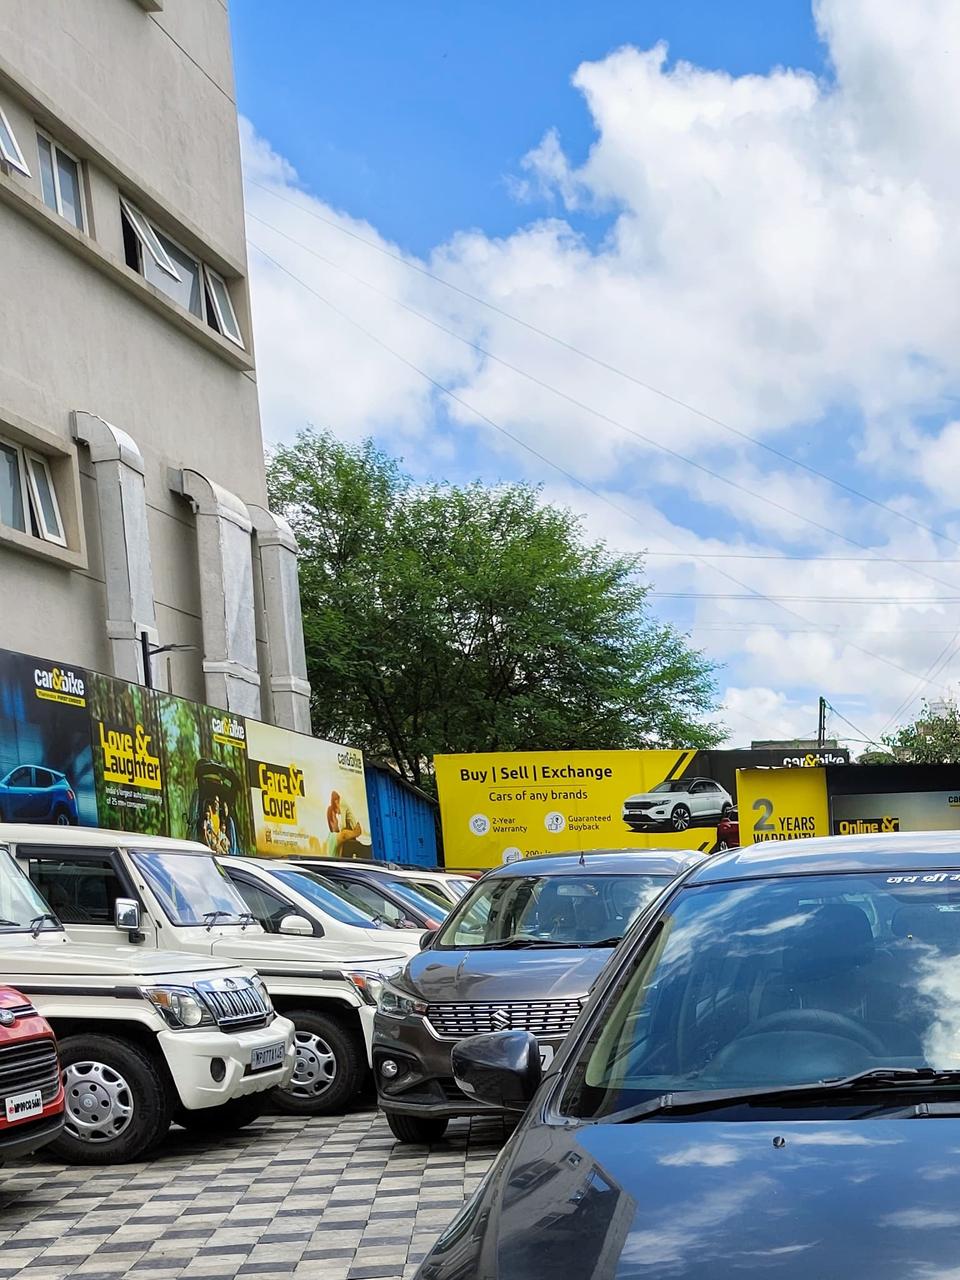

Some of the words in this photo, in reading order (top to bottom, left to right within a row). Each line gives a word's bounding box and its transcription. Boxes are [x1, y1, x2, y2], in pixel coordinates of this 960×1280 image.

[34, 668, 85, 696] car&bike
[212, 716, 245, 740] car&bike
[99, 722, 133, 751] Love
[136, 724, 151, 755] &
[103, 747, 159, 783] Laughter
[783, 753, 845, 768] car&bike
[259, 763, 288, 793] Care
[289, 764, 304, 796] &
[460, 768, 488, 783] Buy
[501, 766, 529, 780] Sell
[542, 764, 613, 780] Exchange
[262, 790, 295, 819] Cover
[489, 791, 513, 802] Cars
[515, 790, 527, 801] of
[530, 792, 548, 802] any
[551, 789, 588, 800] brands
[492, 817, 516, 825] 2-Year
[568, 815, 612, 823] Guaranteed
[752, 798, 775, 832] 2
[778, 816, 816, 832] YEARS
[839, 819, 879, 835] Online
[881, 815, 900, 833] &
[493, 825, 528, 834] Warranty
[568, 823, 600, 832] Buyback
